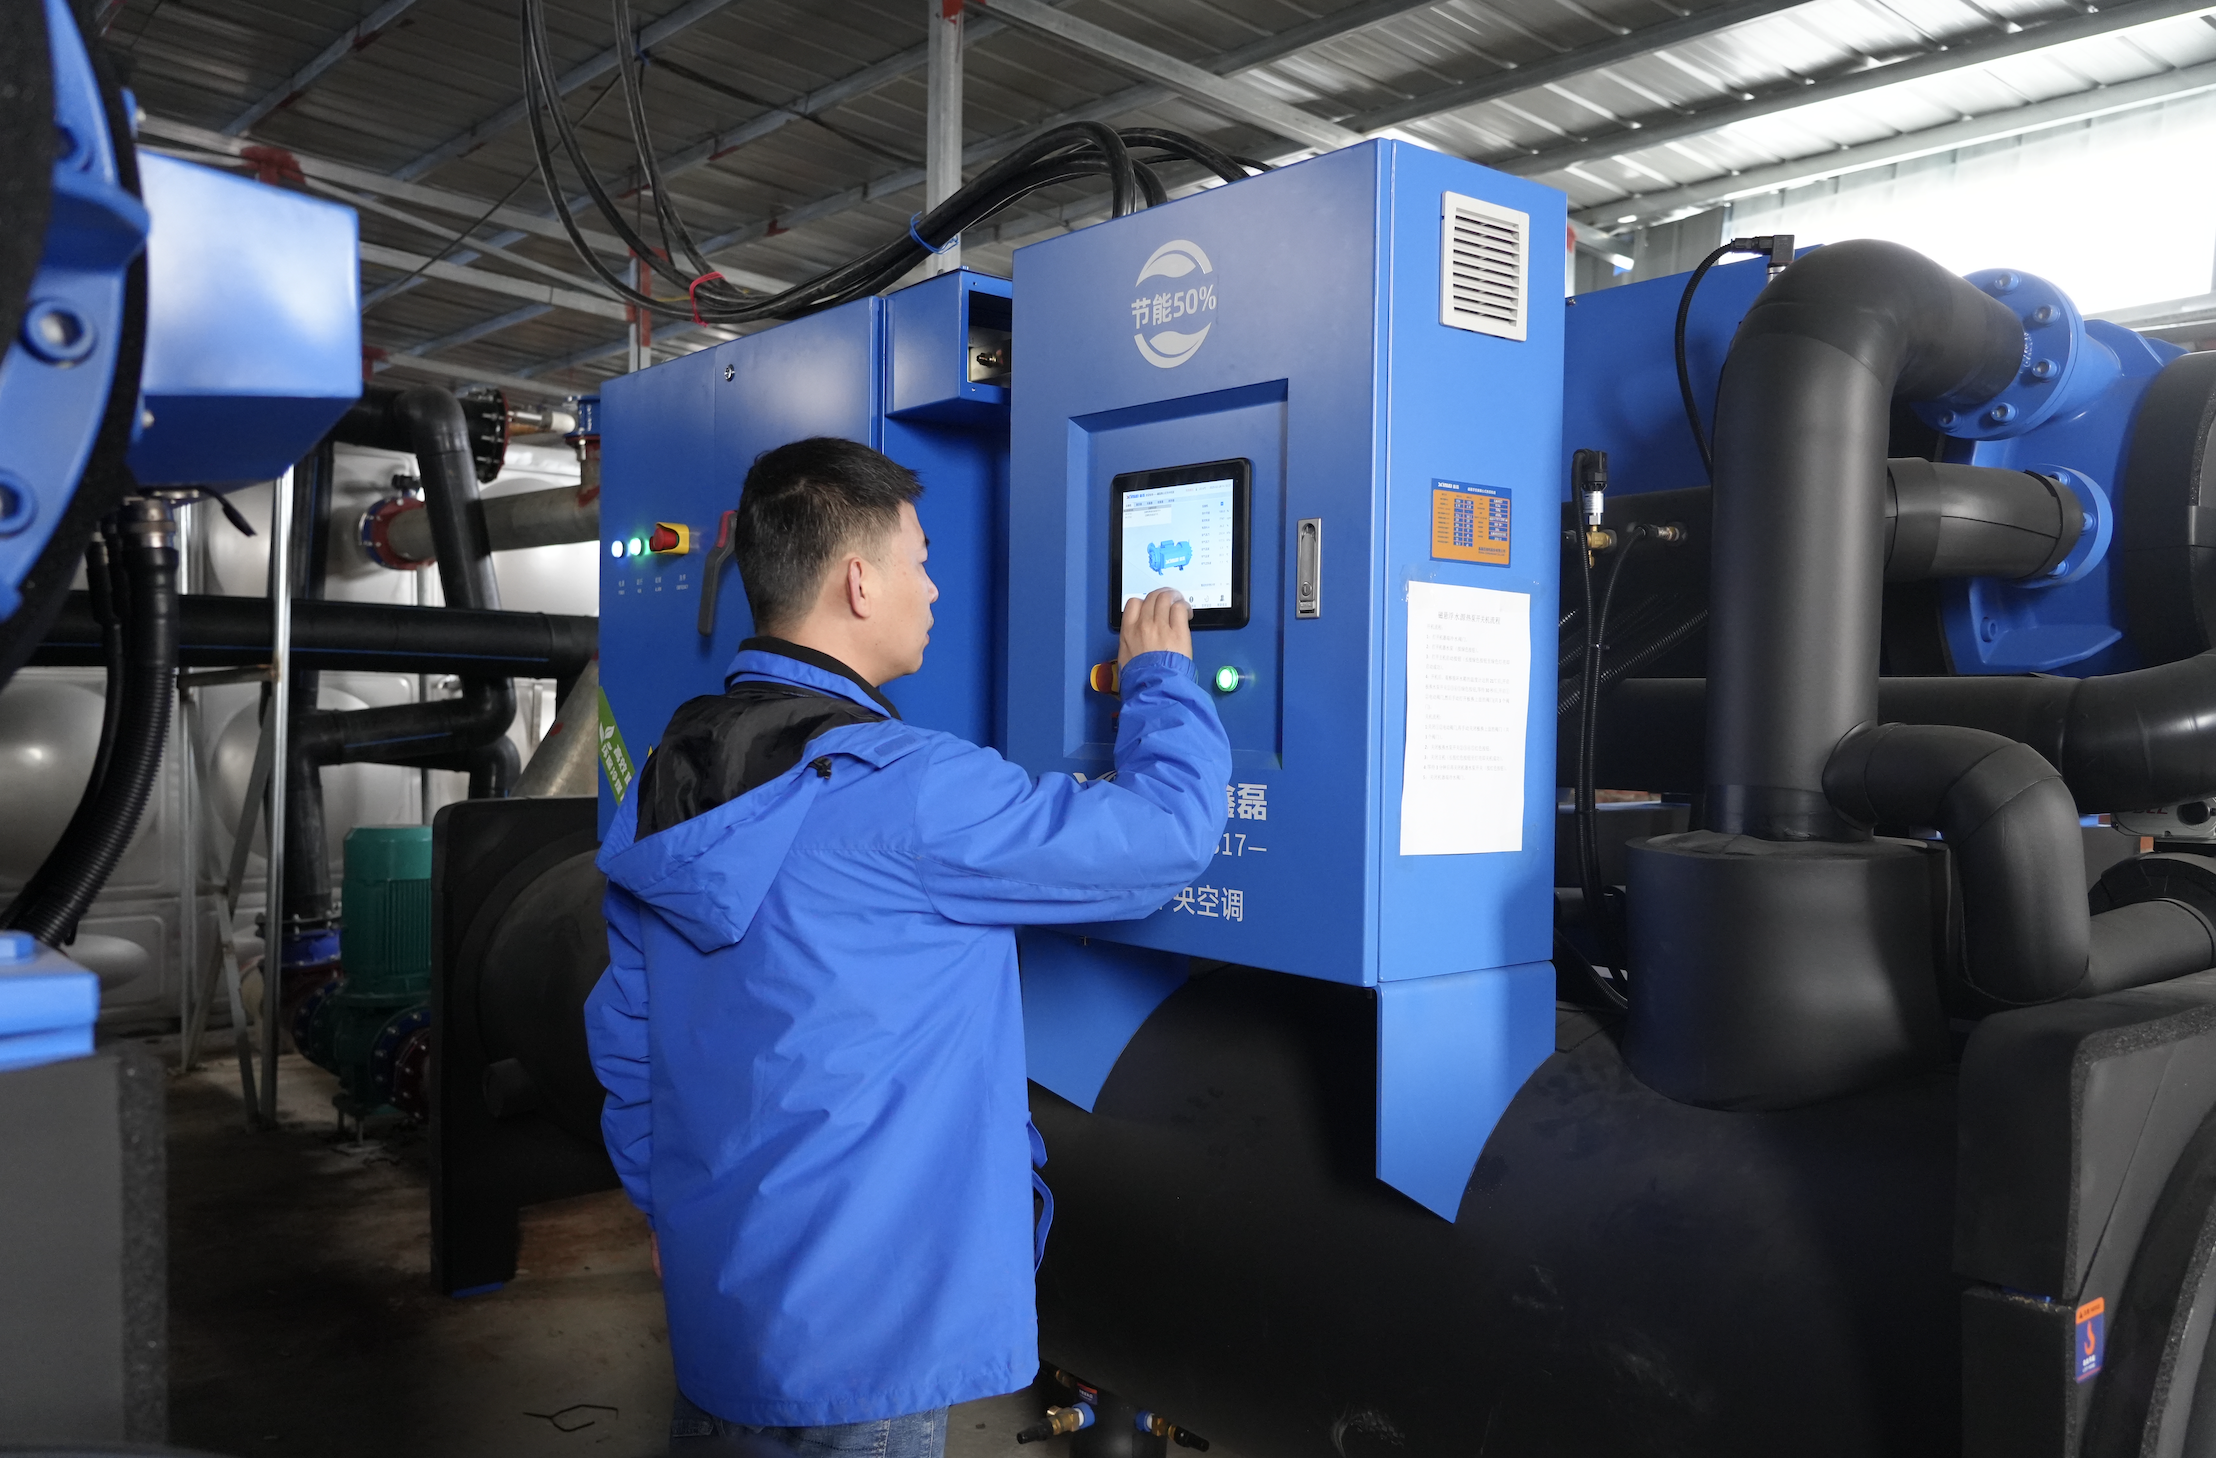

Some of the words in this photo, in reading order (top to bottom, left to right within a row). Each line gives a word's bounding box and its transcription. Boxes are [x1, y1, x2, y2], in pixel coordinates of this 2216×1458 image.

[1131, 284, 1217, 329] 节能50%
[1158, 884, 1244, 922] 央空调
